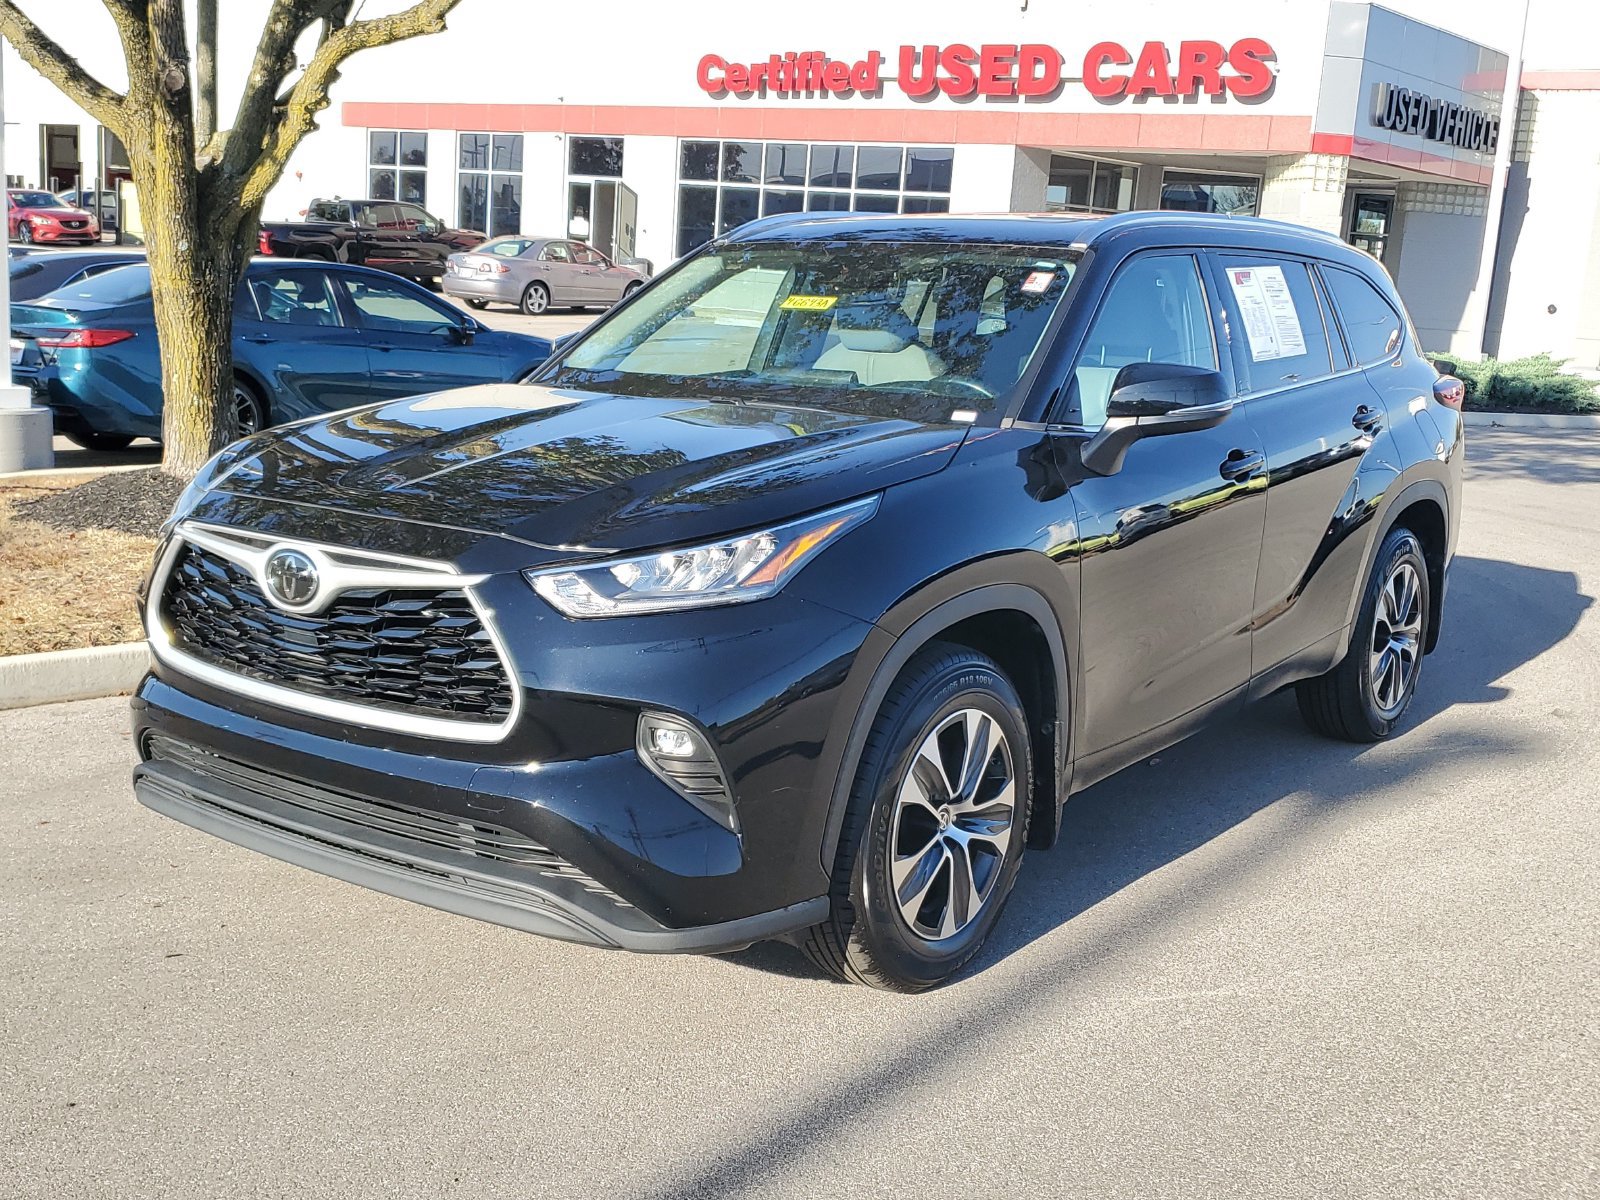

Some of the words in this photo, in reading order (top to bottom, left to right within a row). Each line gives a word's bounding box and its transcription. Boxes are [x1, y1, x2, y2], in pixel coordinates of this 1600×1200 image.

[697, 50, 881, 95] Certified
[897, 44, 1064, 98] USED
[1082, 38, 1276, 98] CARS
[1380, 82, 1431, 136] USED
[1434, 98, 1500, 155] VEHICLE
